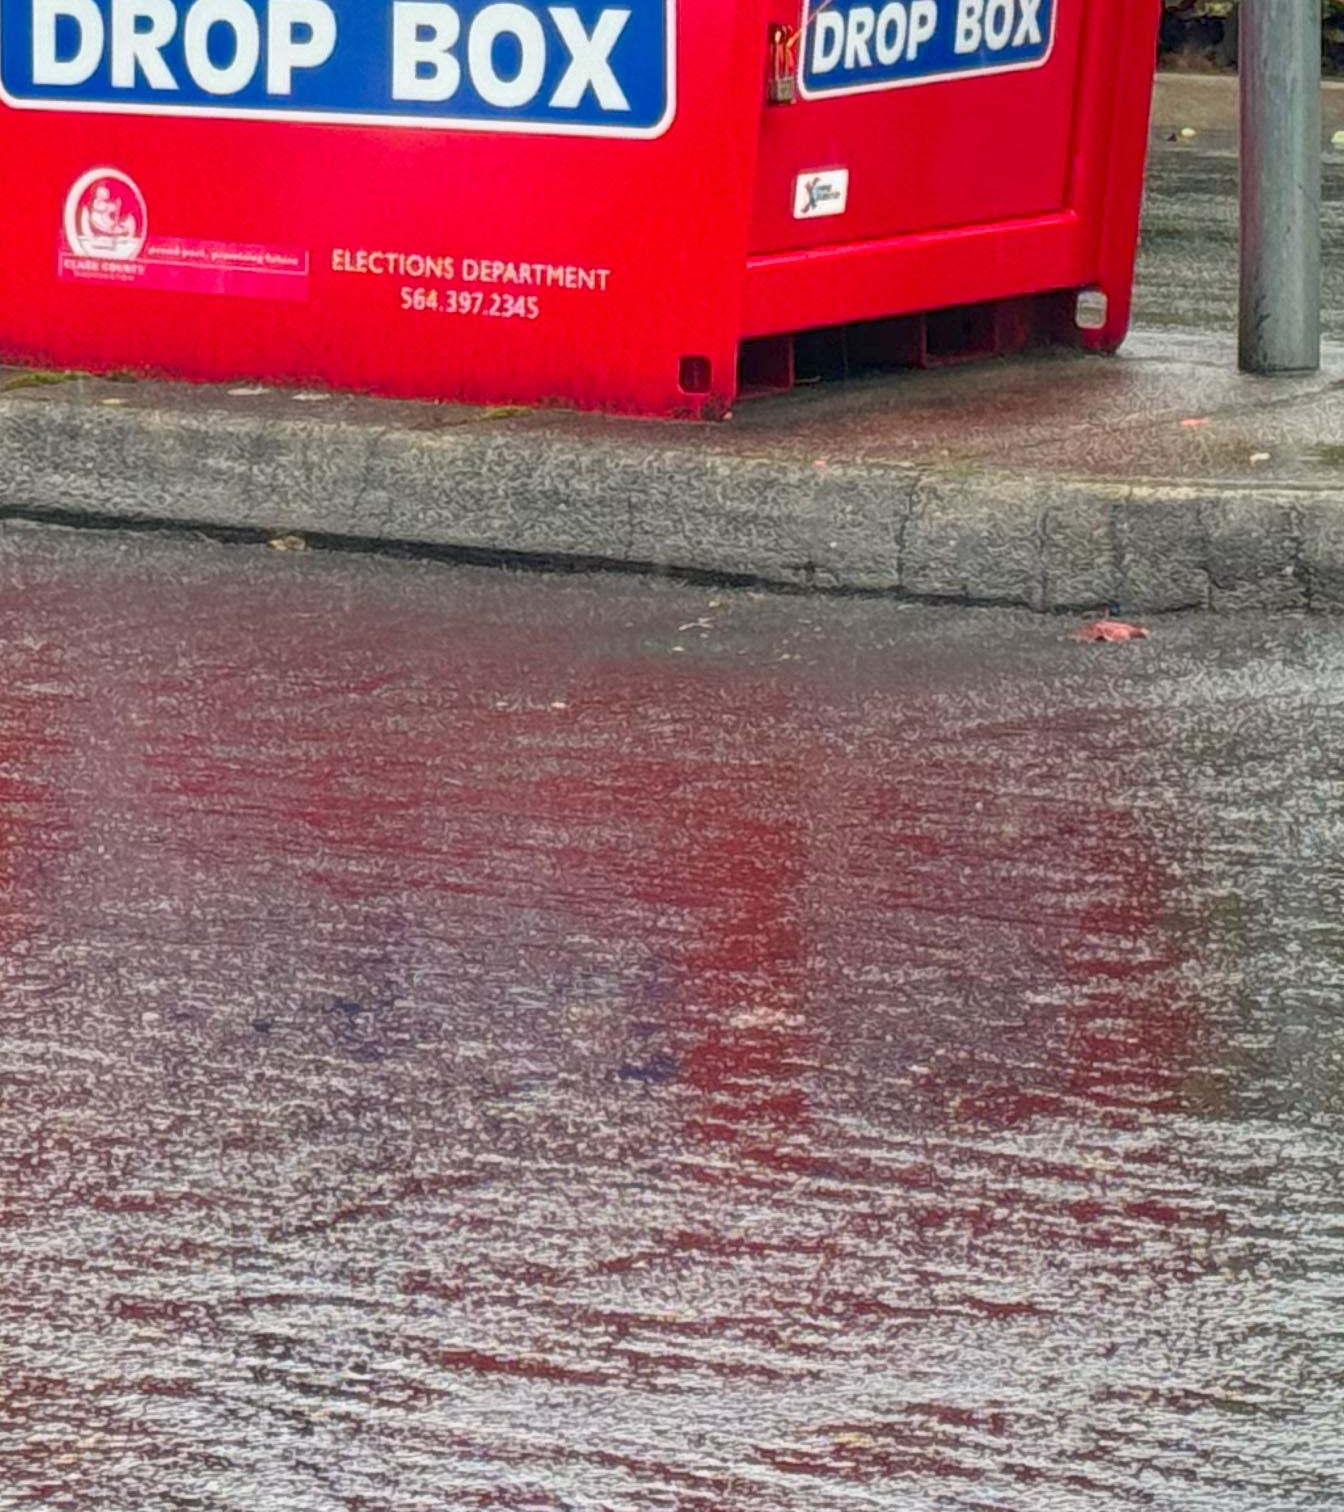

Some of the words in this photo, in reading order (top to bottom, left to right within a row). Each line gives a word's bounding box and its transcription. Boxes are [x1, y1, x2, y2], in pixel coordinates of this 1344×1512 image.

[390, 0, 631, 112] BOX
[812, 0, 937, 74] DROP
[332, 248, 454, 280] ELECTIONS
[462, 258, 611, 290] DEPARTMENT
[400, 287, 540, 319] 564.397.2345
